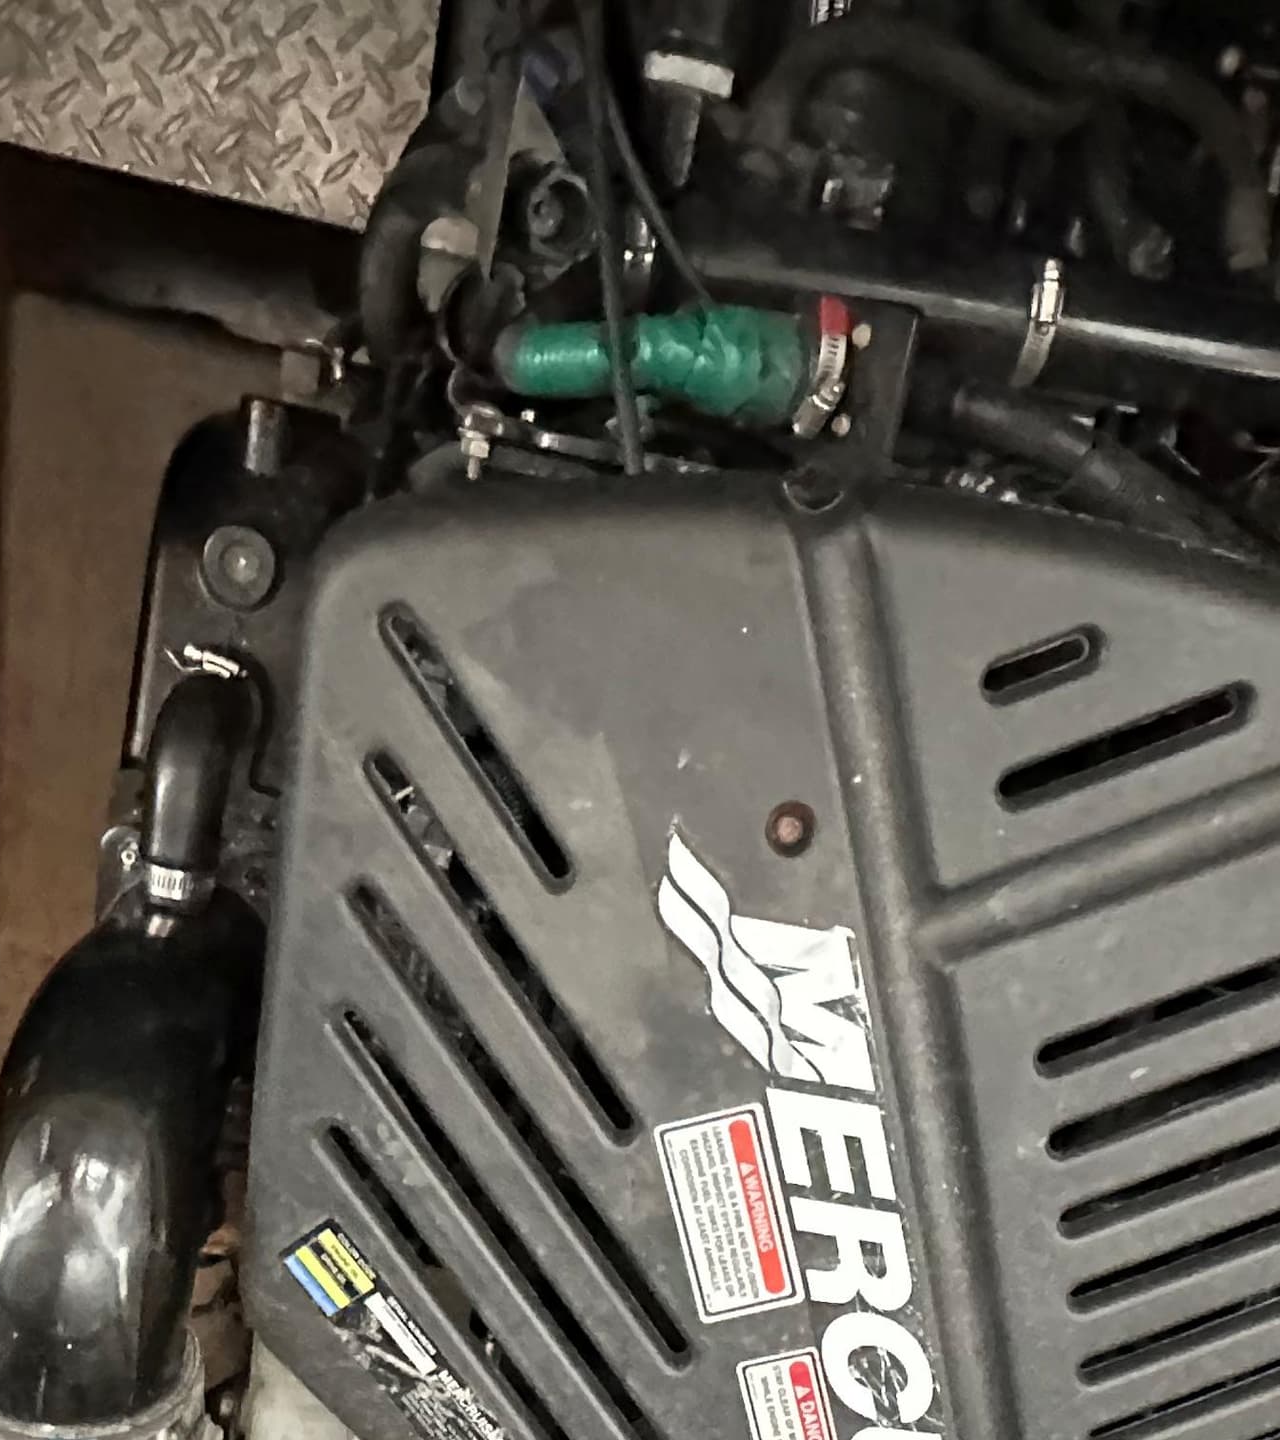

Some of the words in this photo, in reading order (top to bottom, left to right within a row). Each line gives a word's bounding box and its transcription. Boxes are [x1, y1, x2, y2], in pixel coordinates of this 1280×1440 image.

[722, 1166, 734, 1188] FUEL
[743, 1175, 773, 1252] WARNING
[777, 1387, 791, 1416] CLEAR
[785, 1418, 794, 1431] OF
